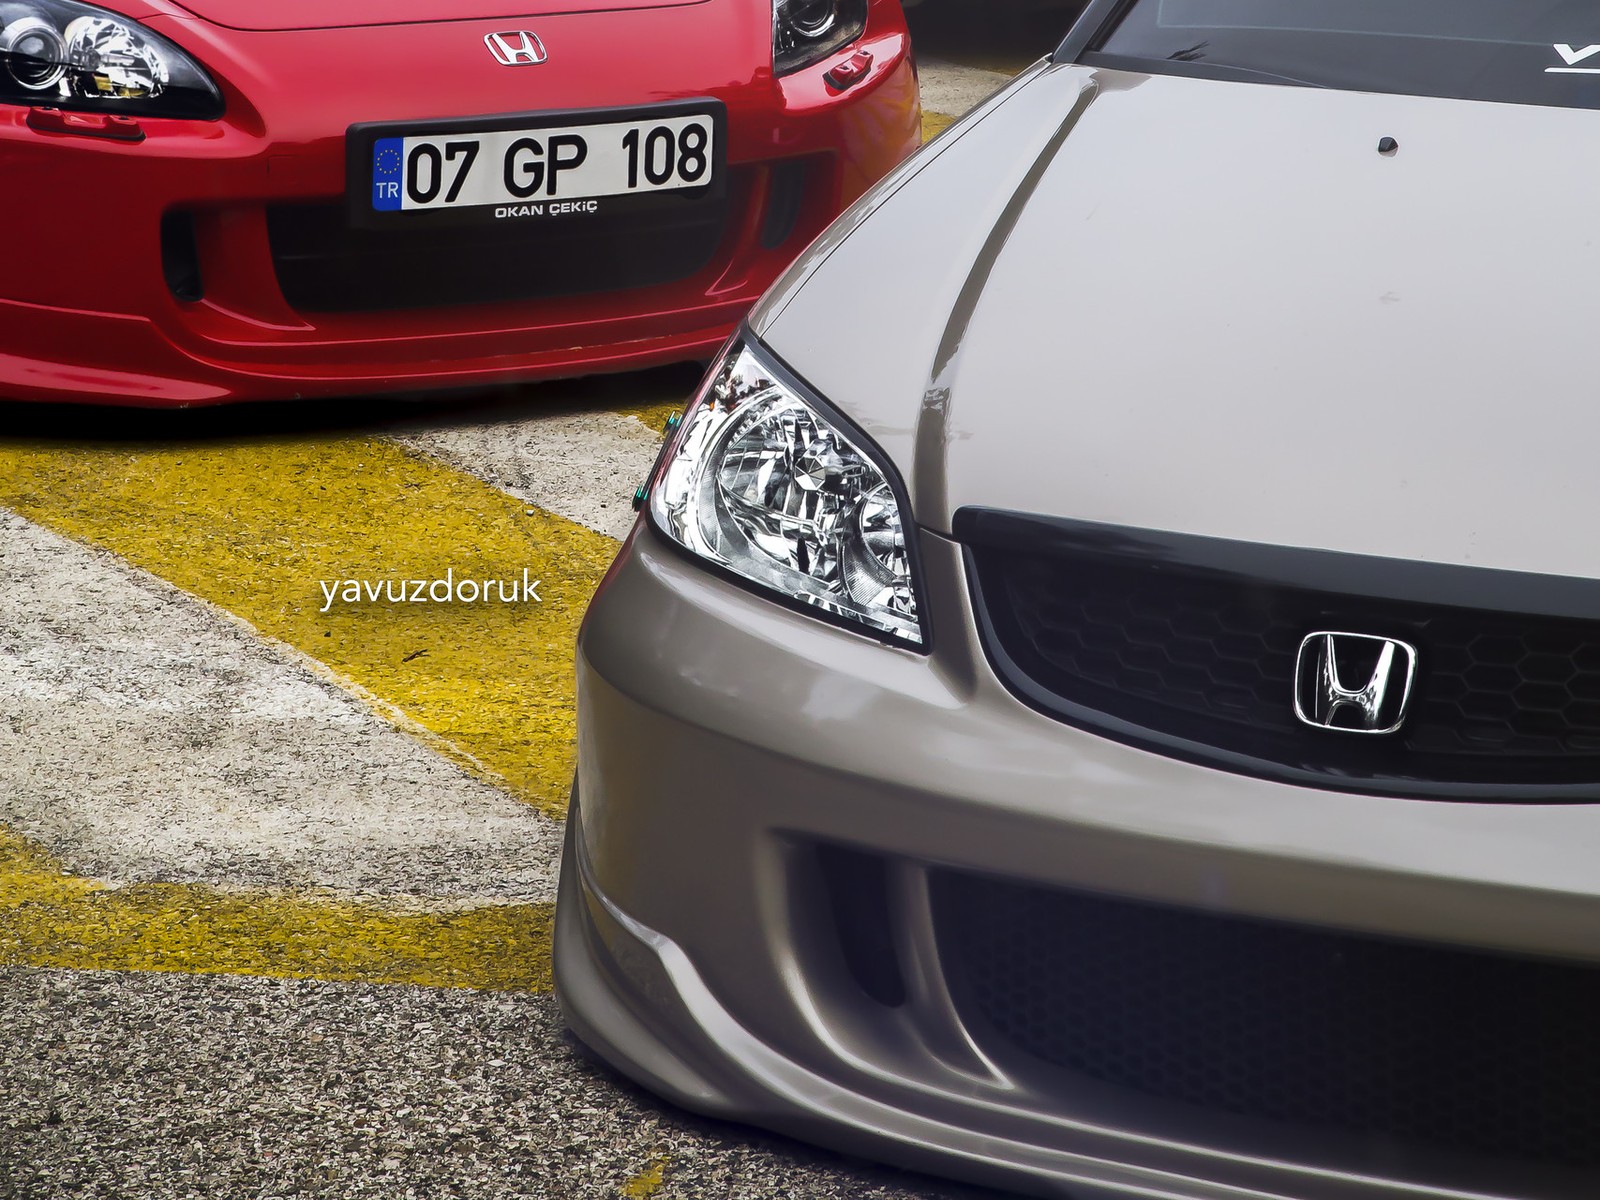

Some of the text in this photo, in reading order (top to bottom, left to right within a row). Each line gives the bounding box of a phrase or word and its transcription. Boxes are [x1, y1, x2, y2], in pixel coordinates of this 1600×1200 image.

[406, 122, 708, 204] 07 GP 108
[376, 181, 399, 200] TR
[495, 204, 544, 218] OKAN
